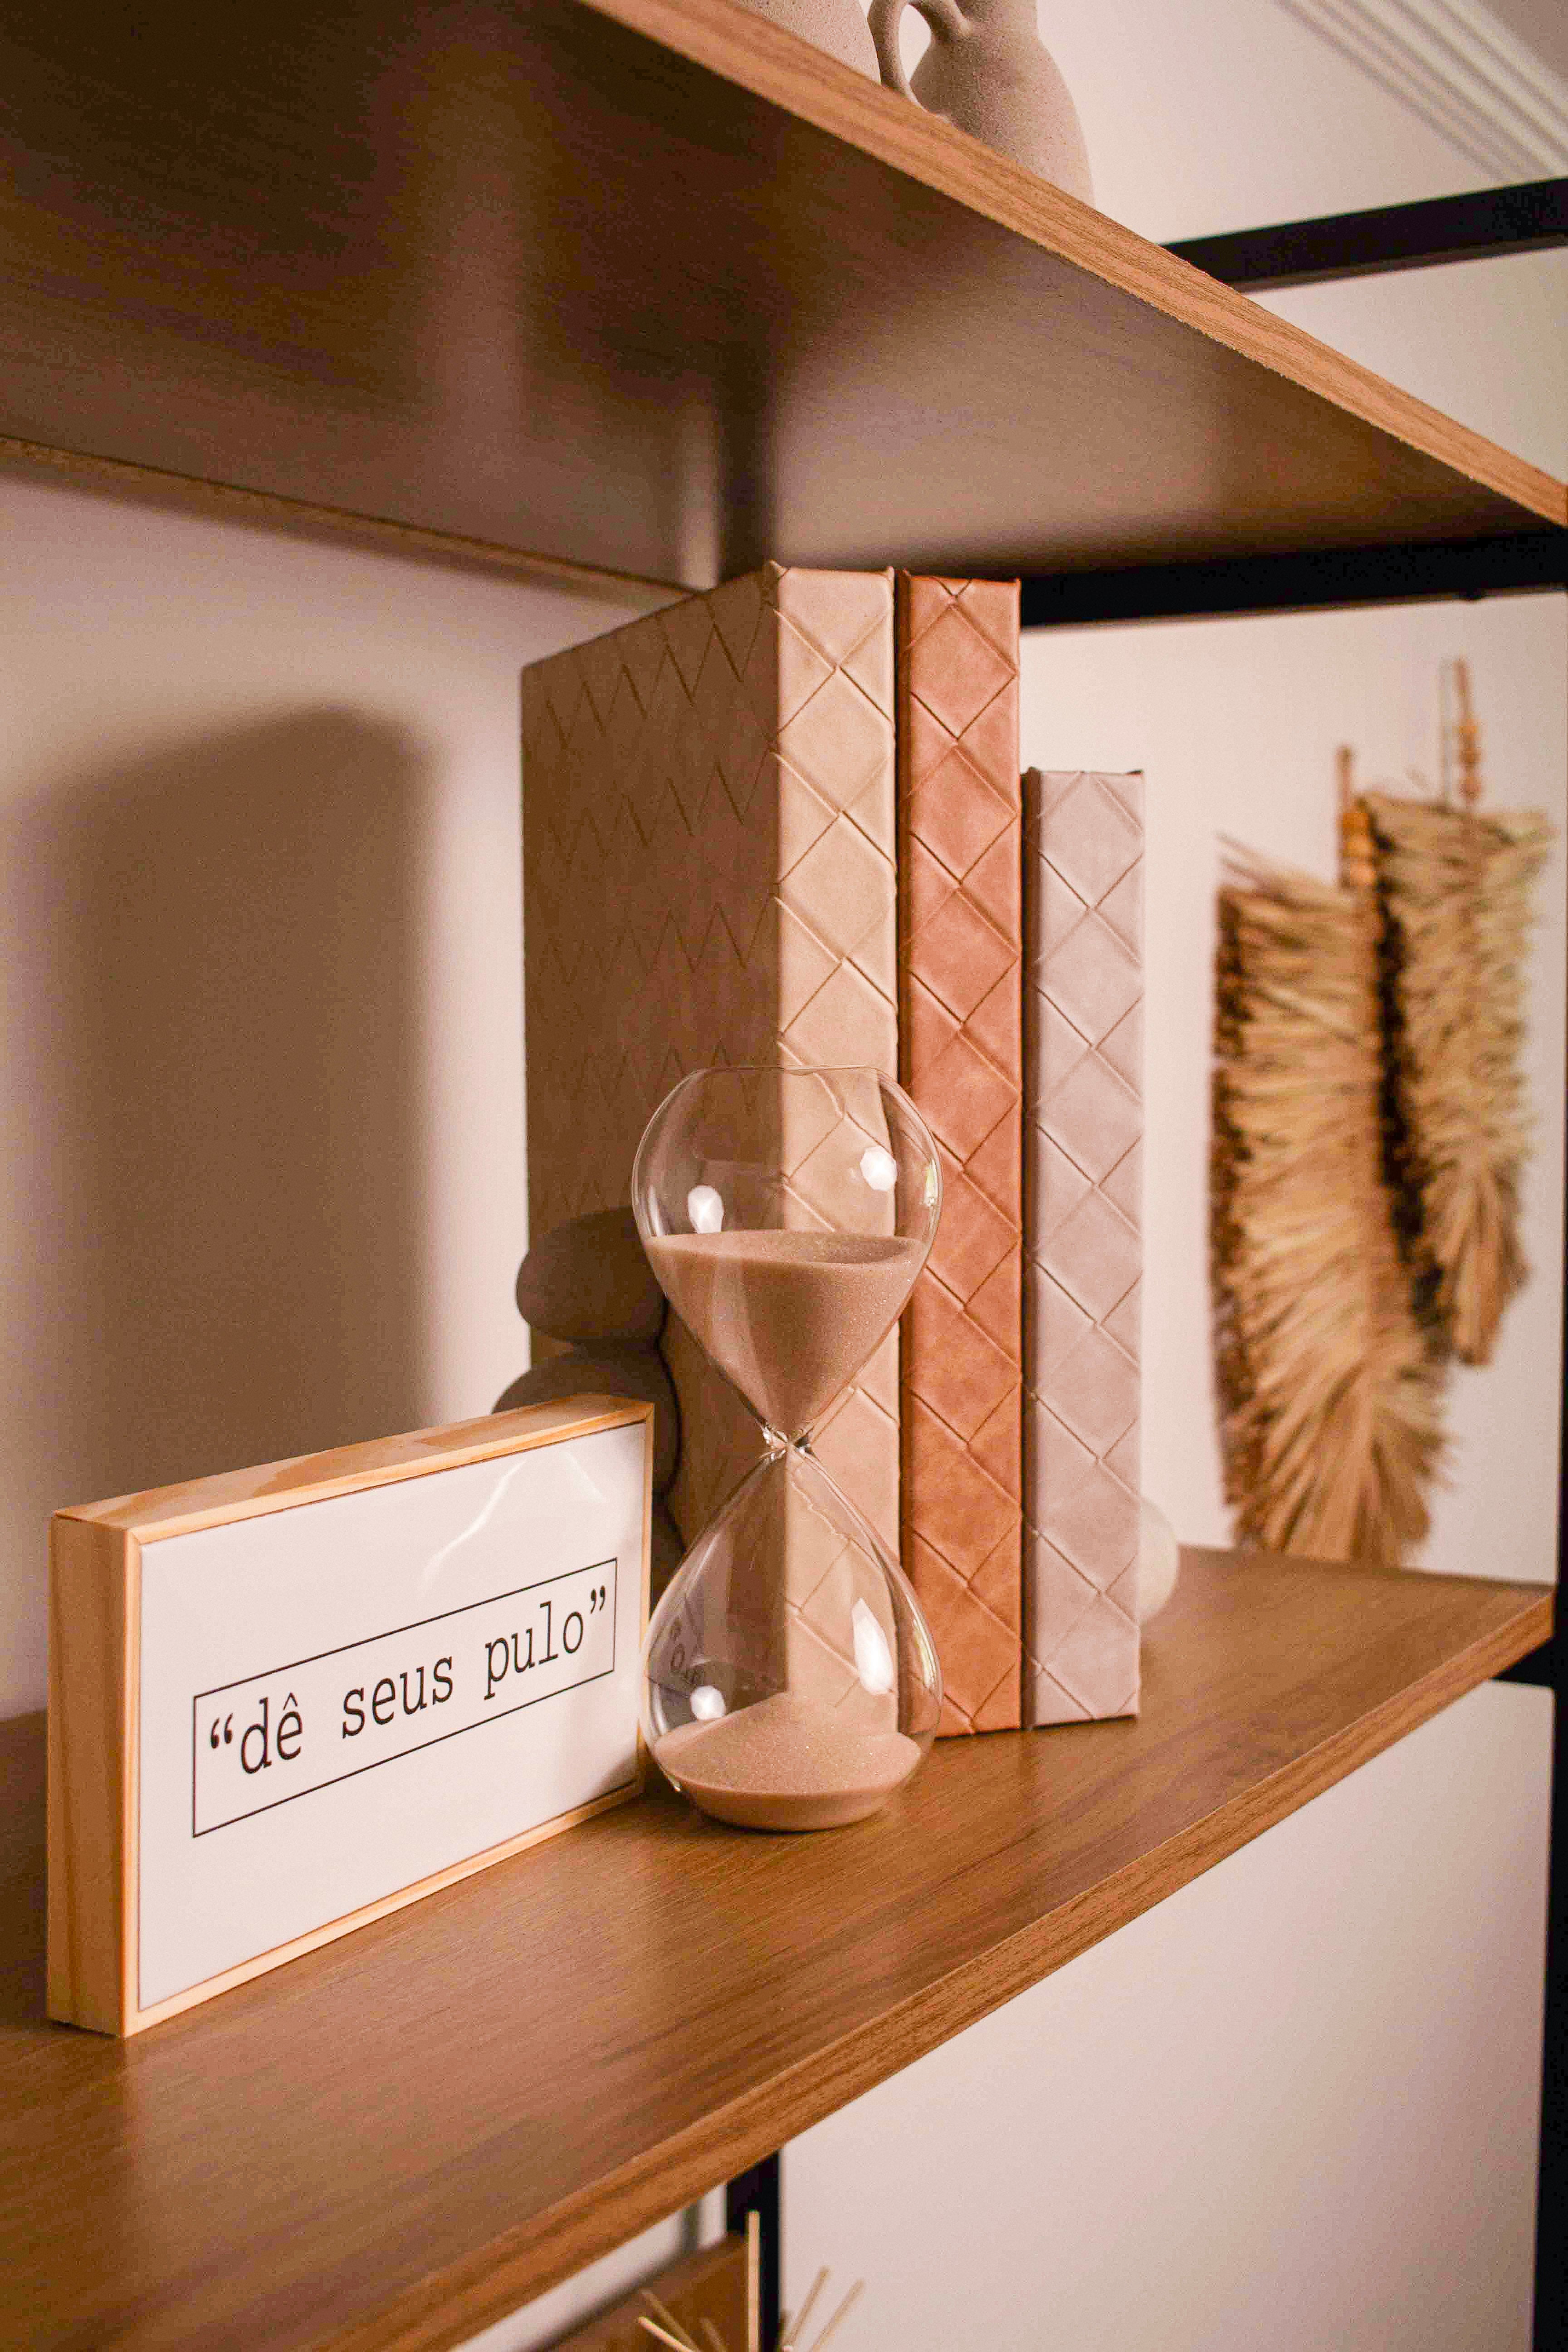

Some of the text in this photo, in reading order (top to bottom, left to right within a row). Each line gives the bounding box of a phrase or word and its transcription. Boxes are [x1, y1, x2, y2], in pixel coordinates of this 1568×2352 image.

[210, 1692, 303, 1774] “dê
[342, 1656, 453, 1740] seus
[484, 1585, 606, 1701] pulo”
